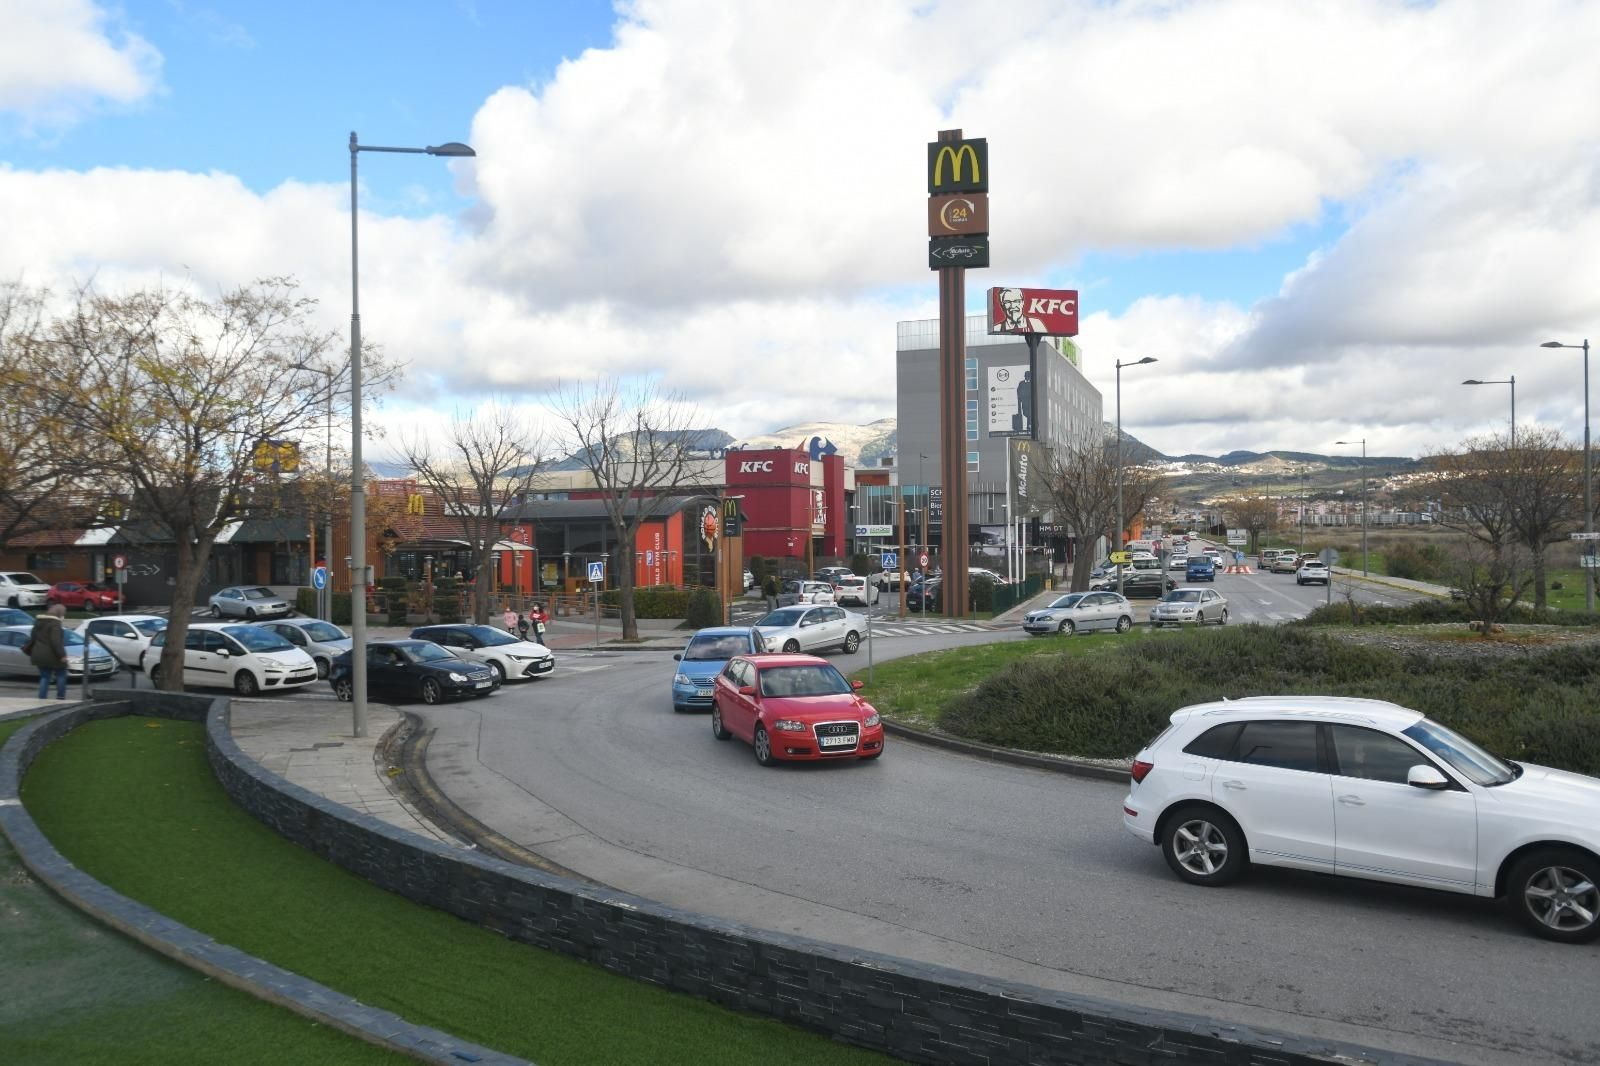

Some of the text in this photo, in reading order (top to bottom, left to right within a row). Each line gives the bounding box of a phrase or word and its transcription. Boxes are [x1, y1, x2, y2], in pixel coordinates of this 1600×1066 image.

[952, 208, 967, 218] 24
[1028, 298, 1075, 316] KFC
[740, 460, 774, 473] KFC
[794, 461, 808, 474] KFC
[1018, 454, 1028, 497] McAuto
